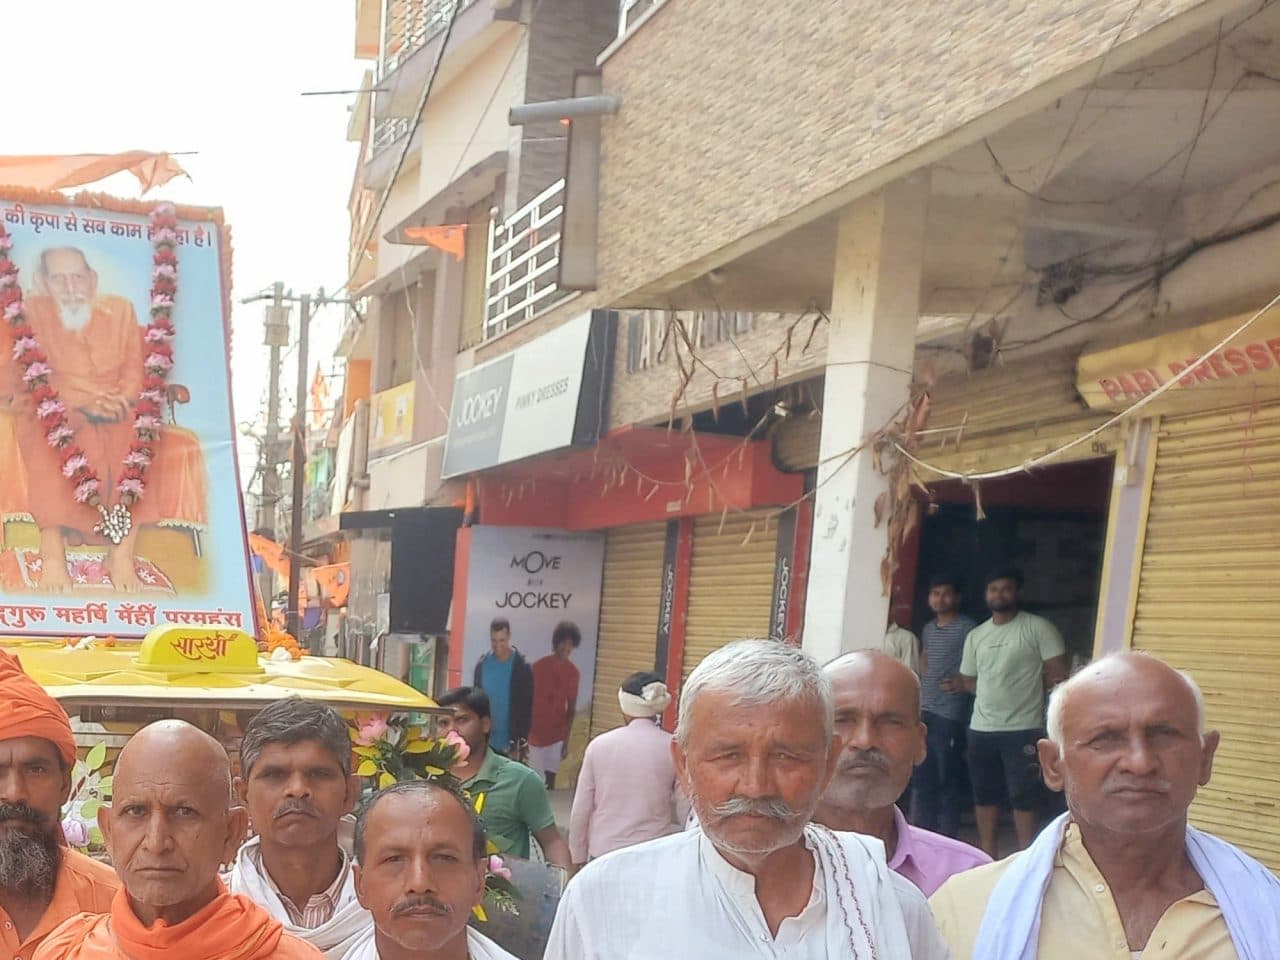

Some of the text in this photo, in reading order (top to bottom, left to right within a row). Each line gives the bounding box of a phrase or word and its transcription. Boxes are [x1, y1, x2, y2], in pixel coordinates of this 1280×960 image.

[4, 202, 25, 226] की
[30, 211, 60, 234] कृपा
[64, 211, 78, 232] से
[110, 221, 142, 240] काम
[456, 386, 503, 428] JOCKEY
[510, 550, 562, 574] MOVE
[53, 602, 108, 625] महर्षि
[495, 591, 572, 610] JOCKEY
[663, 564, 674, 635] JOCKEY
[776, 557, 790, 637] JOCKEY
